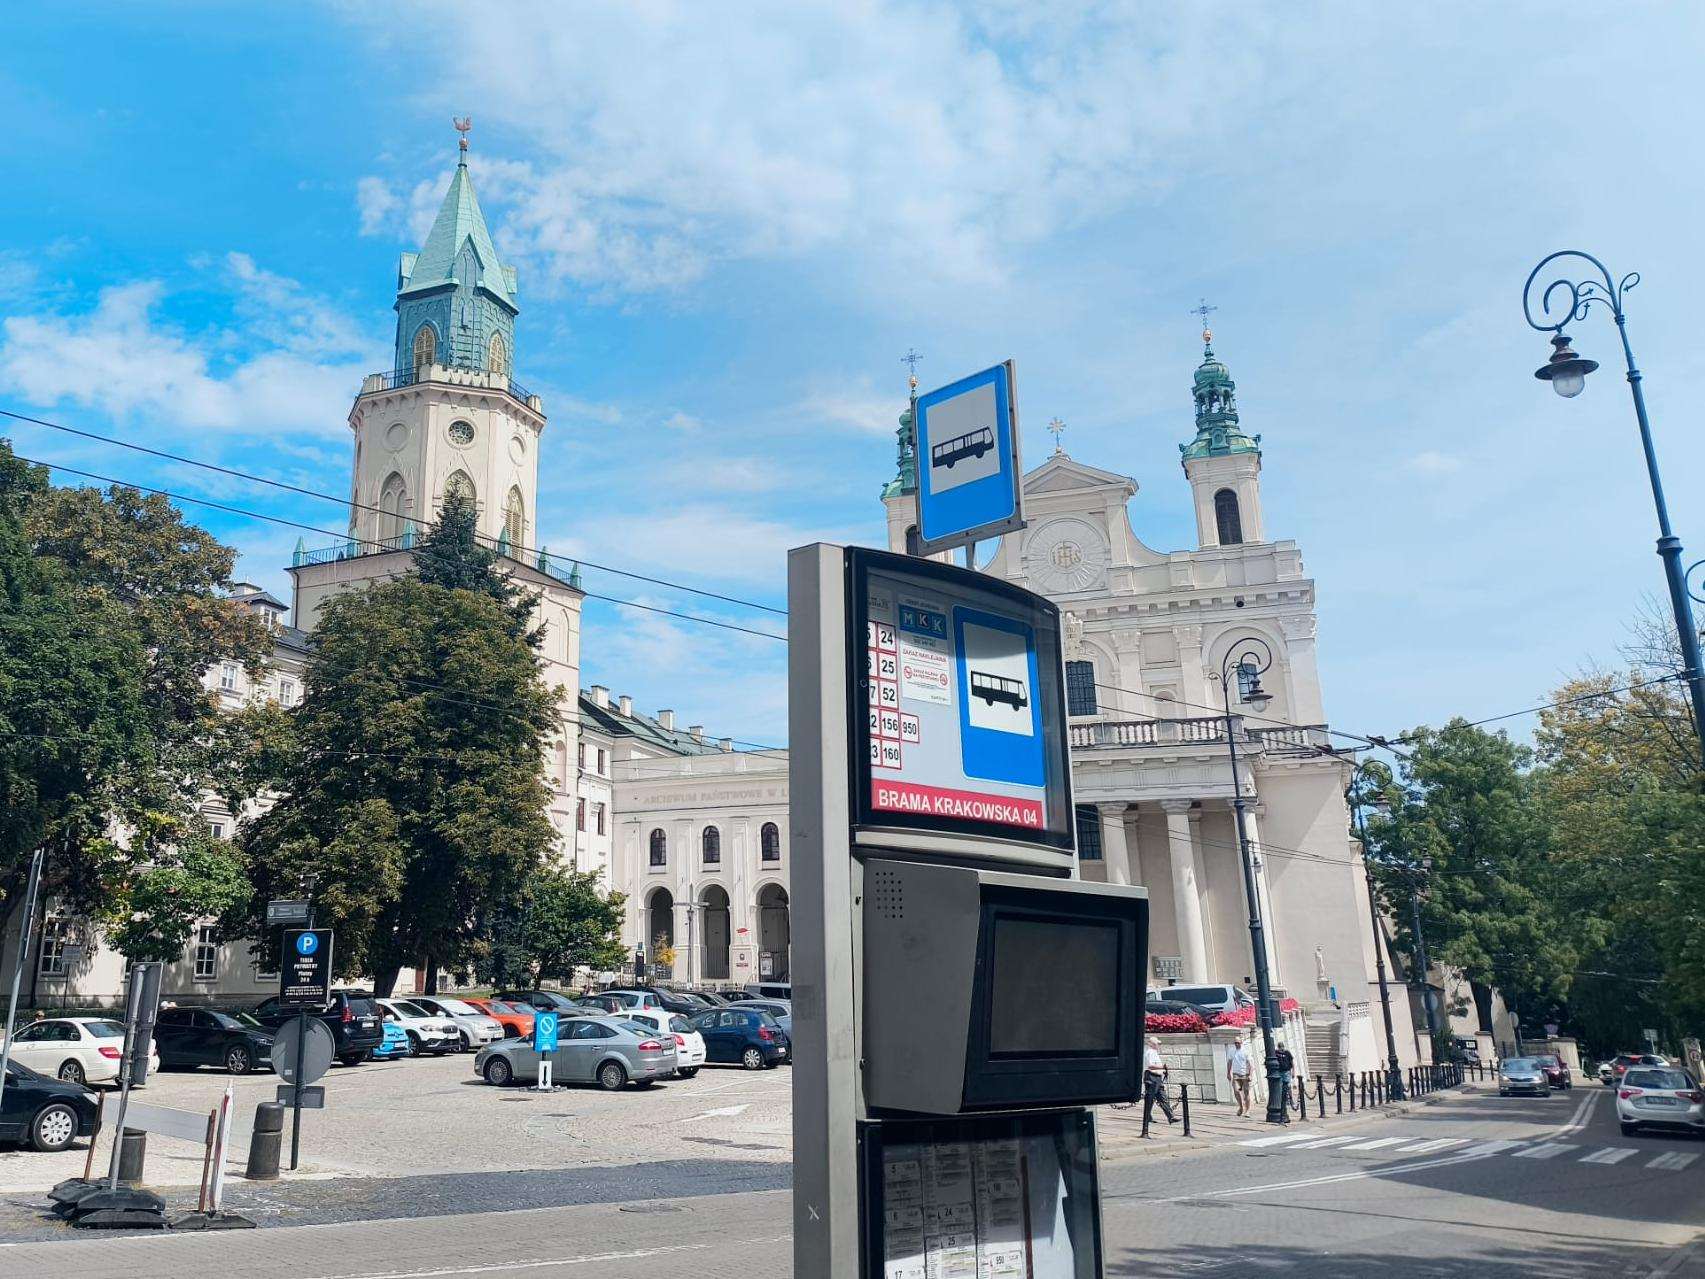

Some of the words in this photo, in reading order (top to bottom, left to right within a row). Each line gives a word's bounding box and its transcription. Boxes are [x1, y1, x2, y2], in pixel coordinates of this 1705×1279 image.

[881, 630, 893, 646] 24
[881, 660, 894, 674] 25
[869, 686, 876, 699] 7
[882, 688, 895, 702] 52
[870, 715, 877, 728] 2
[882, 718, 898, 731] 156
[903, 721, 917, 735] 950
[871, 745, 878, 759] 3
[883, 747, 899, 761] 160
[878, 788, 932, 812] BRAMA
[934, 796, 1021, 823] KRAKOWSKA
[1023, 808, 1038, 826] 04
